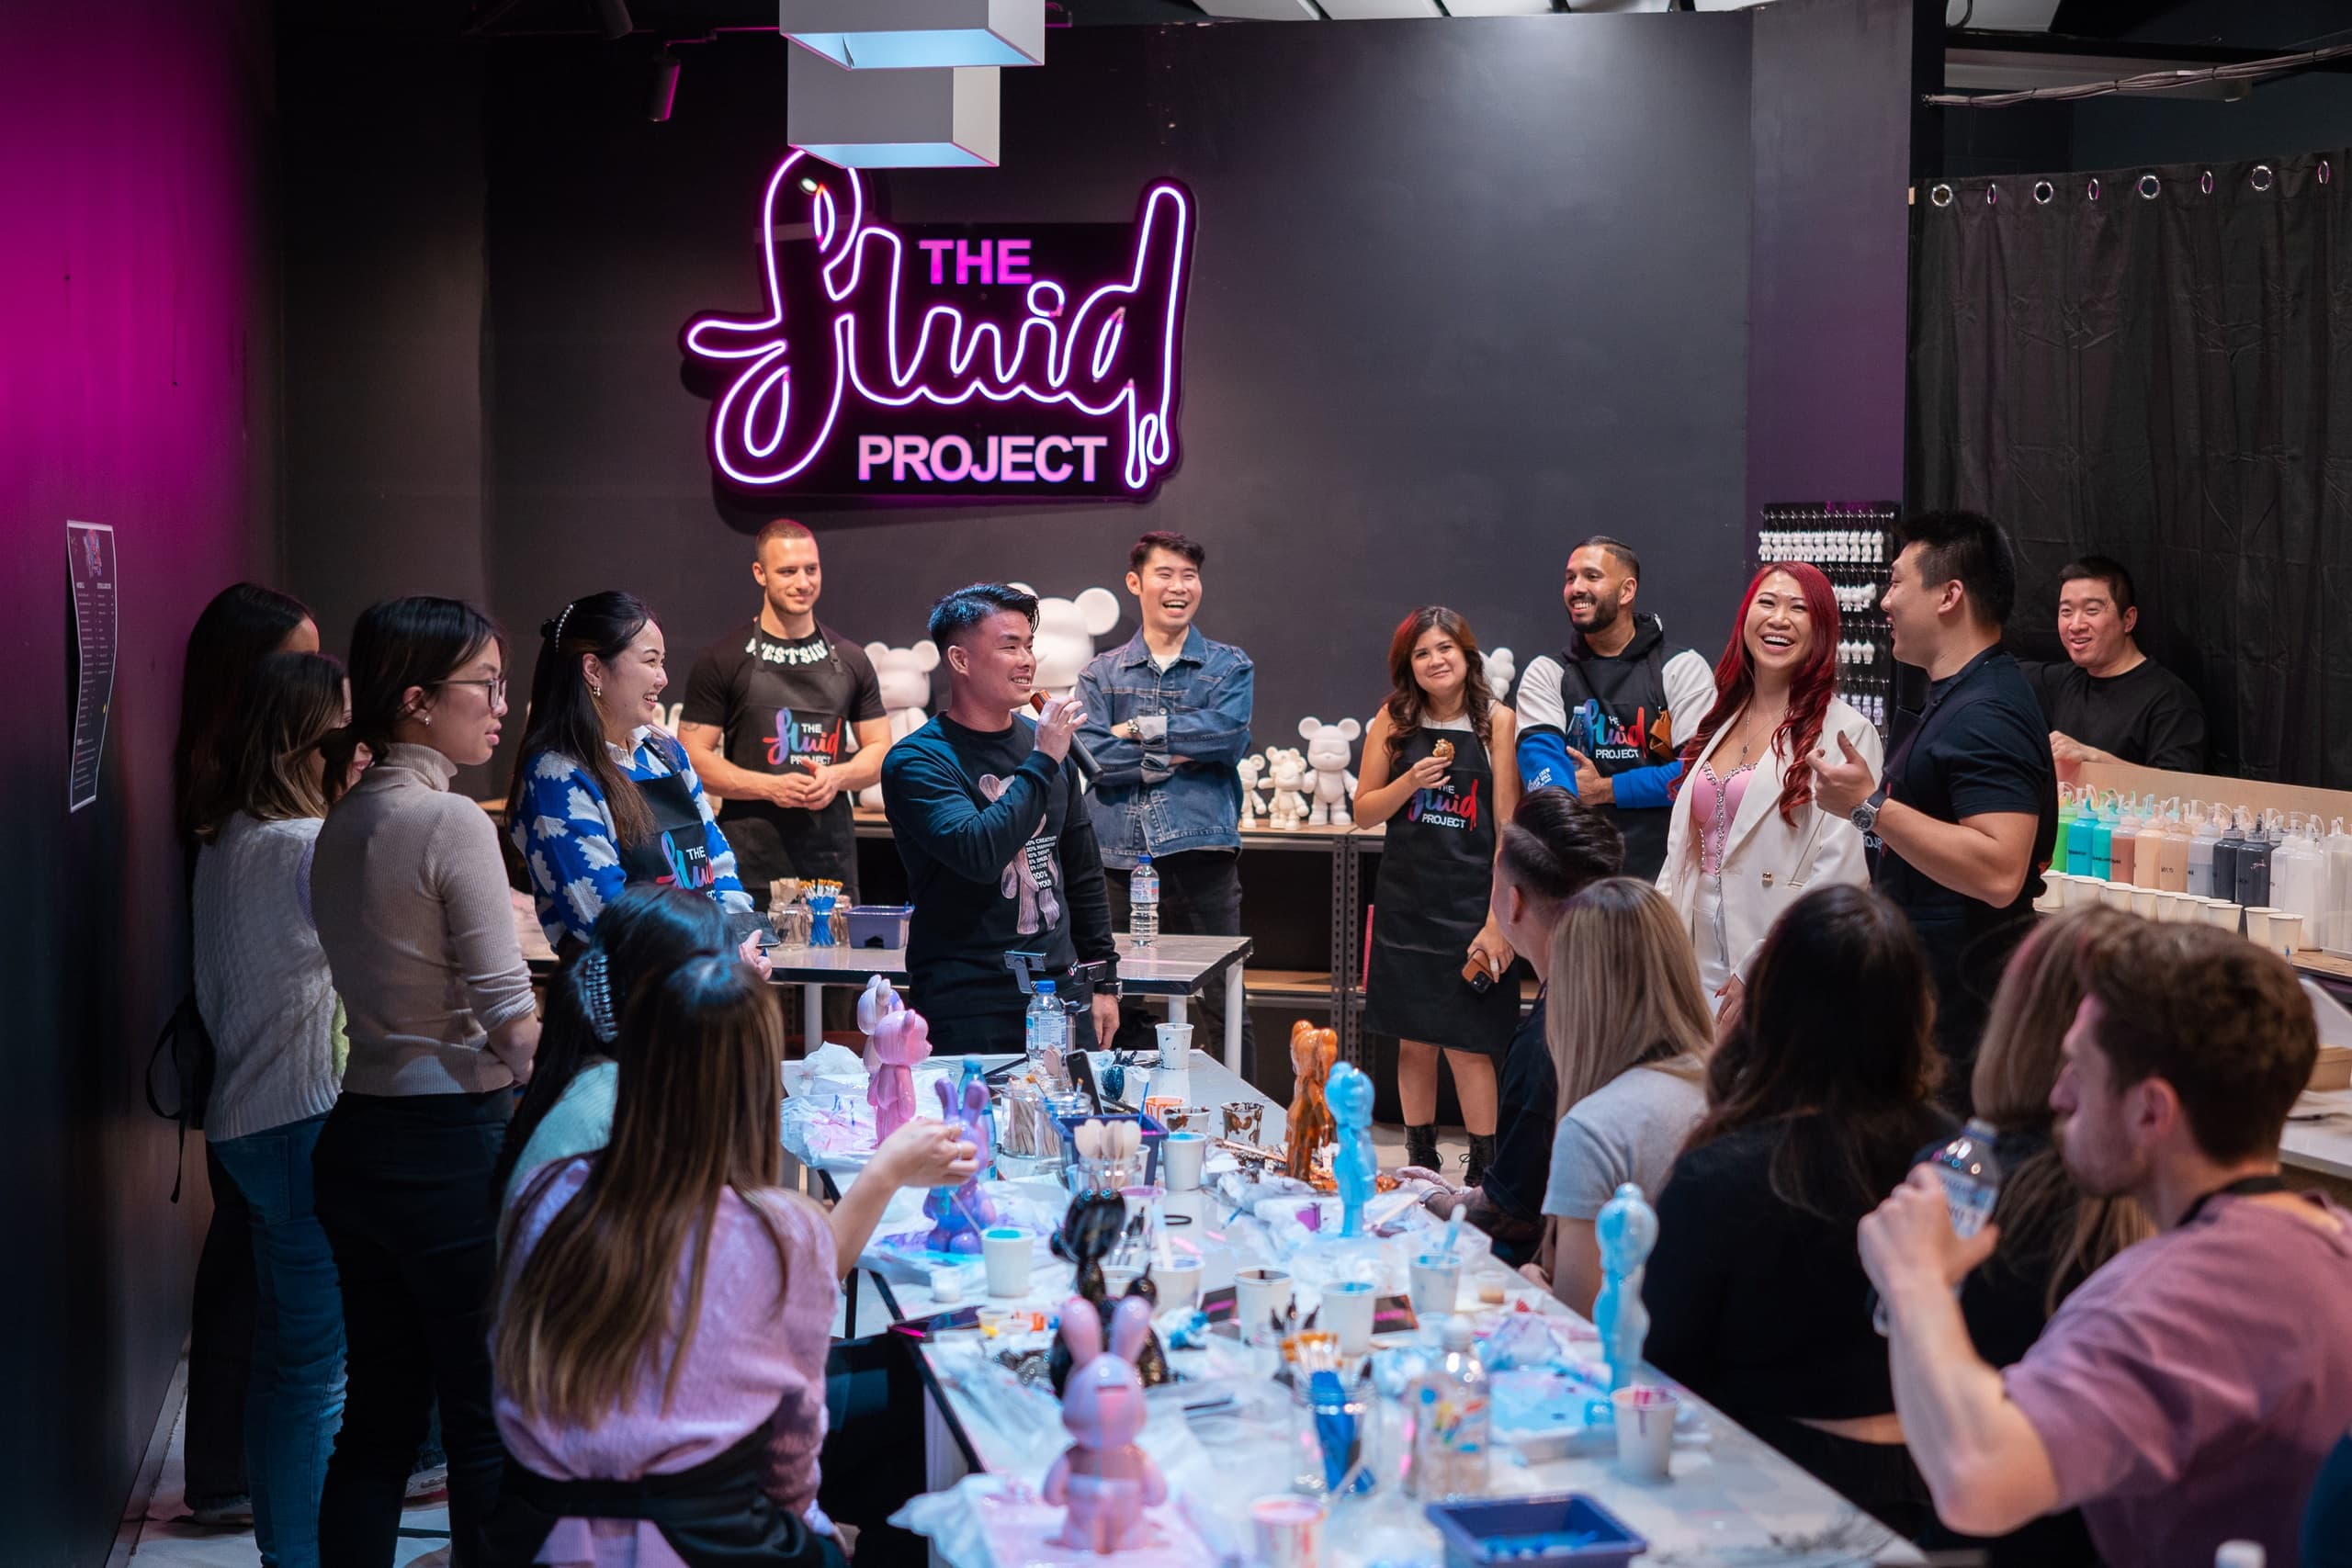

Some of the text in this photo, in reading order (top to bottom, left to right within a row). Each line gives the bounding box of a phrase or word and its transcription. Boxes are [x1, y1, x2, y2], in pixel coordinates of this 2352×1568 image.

[919, 239, 1032, 285] THE
[858, 434, 1107, 482] PROJECT
[763, 706, 842, 765] fluid
[801, 723, 822, 733] THE
[790, 754, 831, 765] PRJECT
[1595, 749, 1639, 759] PROJECT
[1421, 813, 1466, 829] PROJECT
[685, 845, 706, 860] THE
